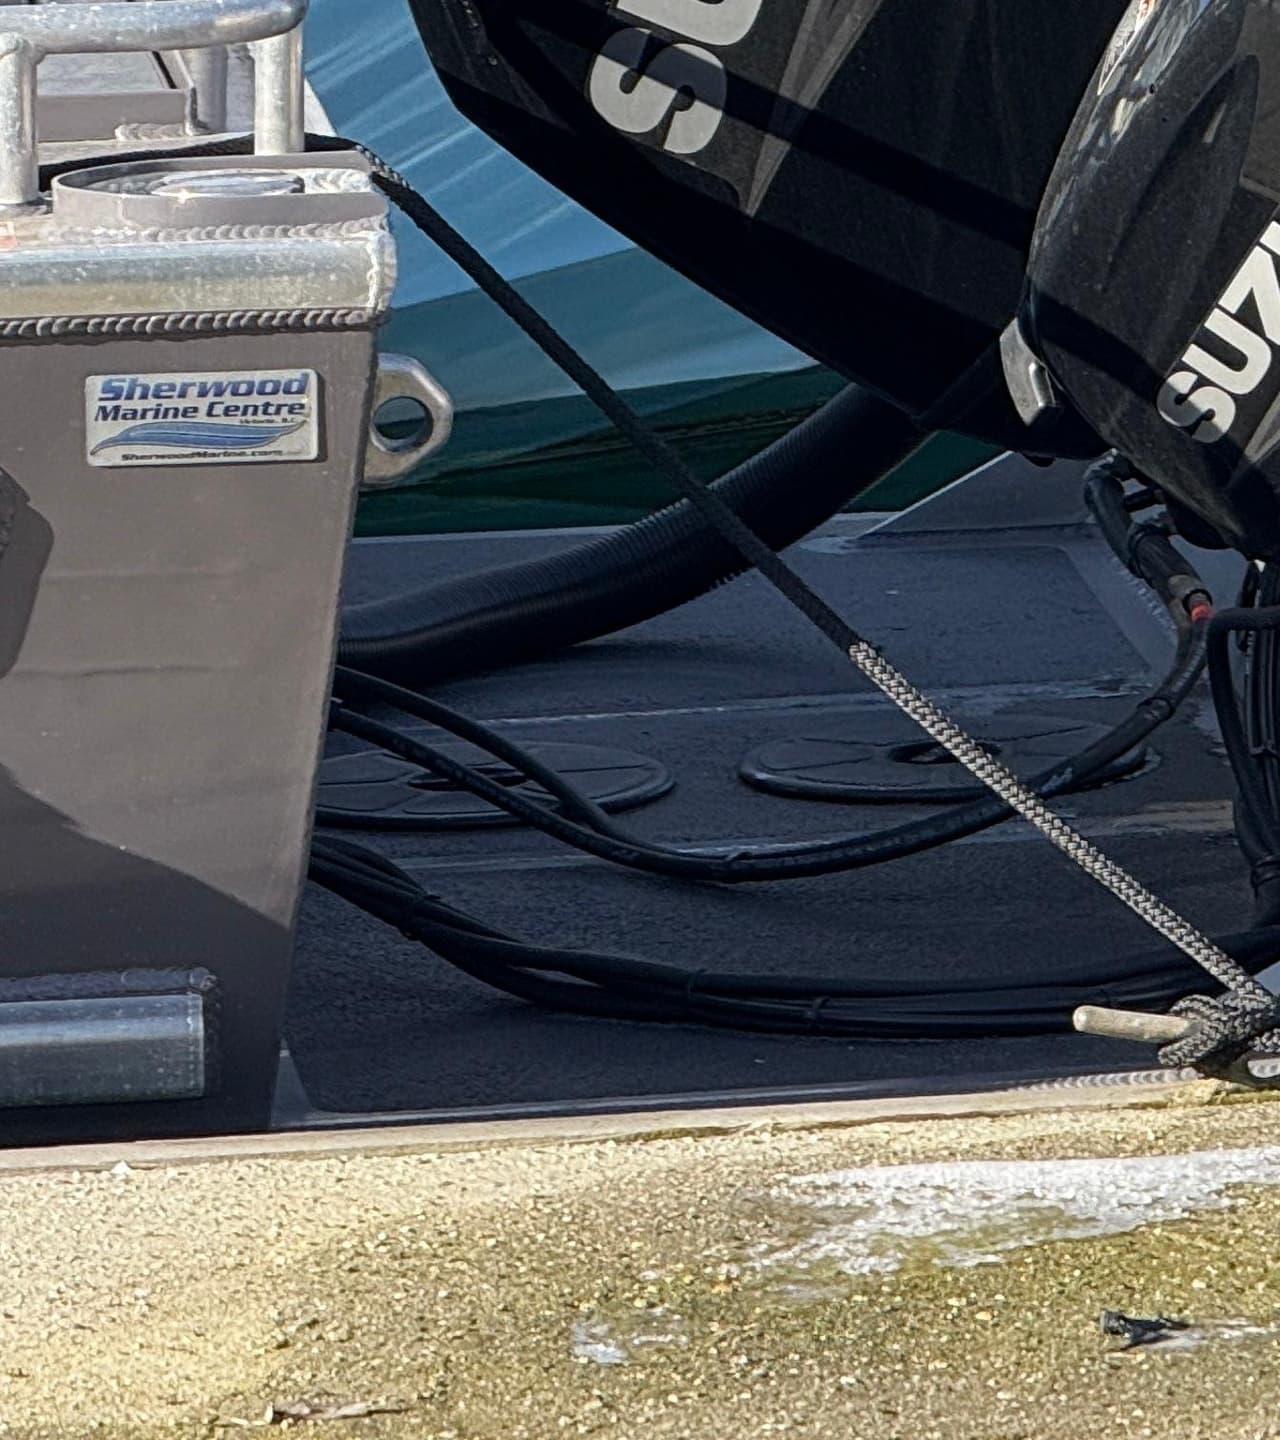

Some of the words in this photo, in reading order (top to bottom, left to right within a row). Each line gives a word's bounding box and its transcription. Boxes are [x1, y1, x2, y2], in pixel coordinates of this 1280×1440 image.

[97, 372, 310, 402] Sherwood
[94, 402, 198, 422] Marine
[206, 400, 306, 419] Centre
